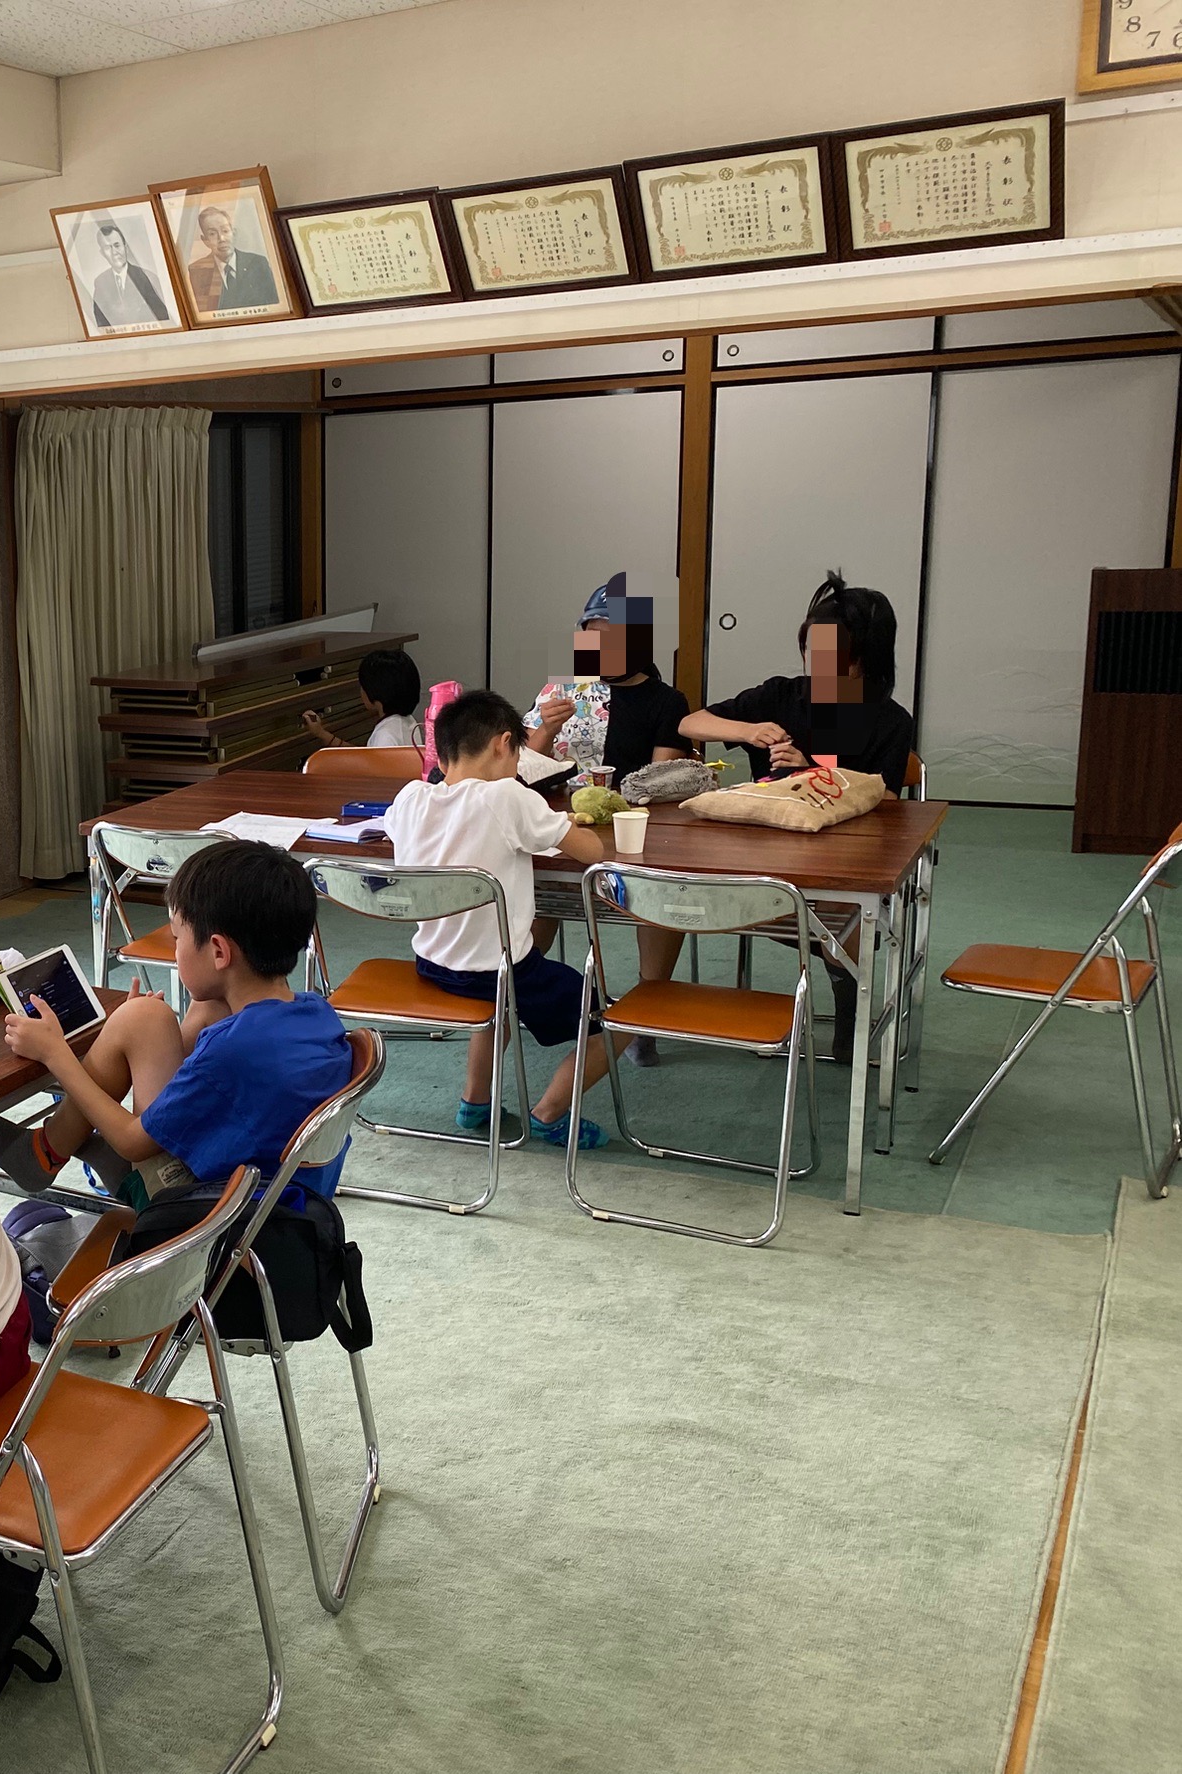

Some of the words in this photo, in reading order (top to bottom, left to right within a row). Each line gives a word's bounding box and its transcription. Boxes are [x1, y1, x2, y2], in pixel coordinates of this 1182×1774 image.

[1126, 16, 1141, 33] 8
[1146, 30, 1161, 48] 7
[1172, 31, 1182, 48] 6
[1002, 155, 1014, 207] 表彰状
[780, 185, 793, 233] 表彰状
[574, 692, 604, 702] dance
